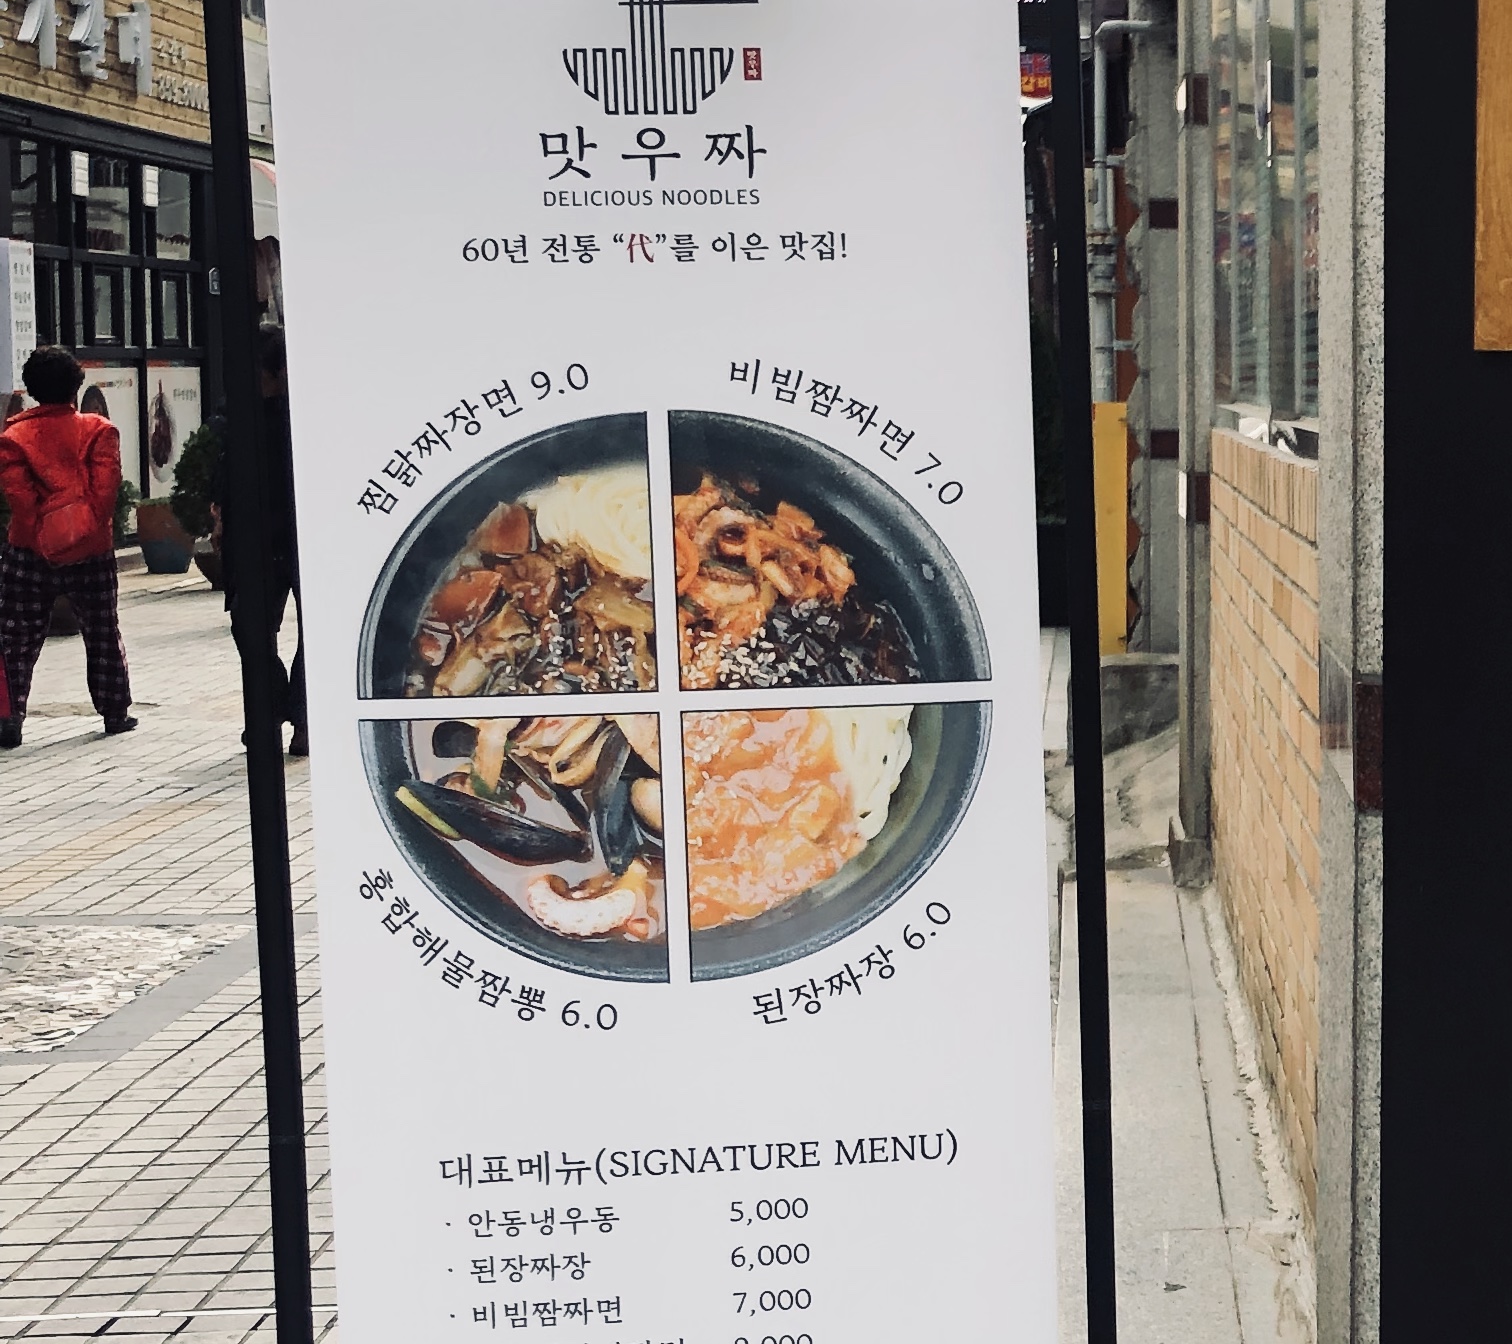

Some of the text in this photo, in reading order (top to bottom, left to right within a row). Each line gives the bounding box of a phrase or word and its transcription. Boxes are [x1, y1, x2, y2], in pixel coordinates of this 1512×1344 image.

[544, 189, 759, 206] DELICIOUS NOODLES
[463, 234, 529, 263] 60년
[542, 234, 600, 264] 전통
[712, 232, 769, 262] 이은
[780, 231, 847, 261] 맛집!
[356, 362, 591, 515] 찜닭짜장면 9.0
[729, 357, 964, 506] 비빔짬짜면 7.0
[359, 868, 618, 1031] 홍합해물짬뽕 6.0
[752, 901, 952, 1025] 된장짜장 6.0
[439, 1128, 957, 1188] 대표메뉴(SIGNATURE MENU)
[469, 1198, 808, 1237] 안동냉우동 5,000
[470, 1243, 810, 1283] 된장짜장 6,000
[473, 1289, 811, 1329] 비빔짬짜면 7,000
